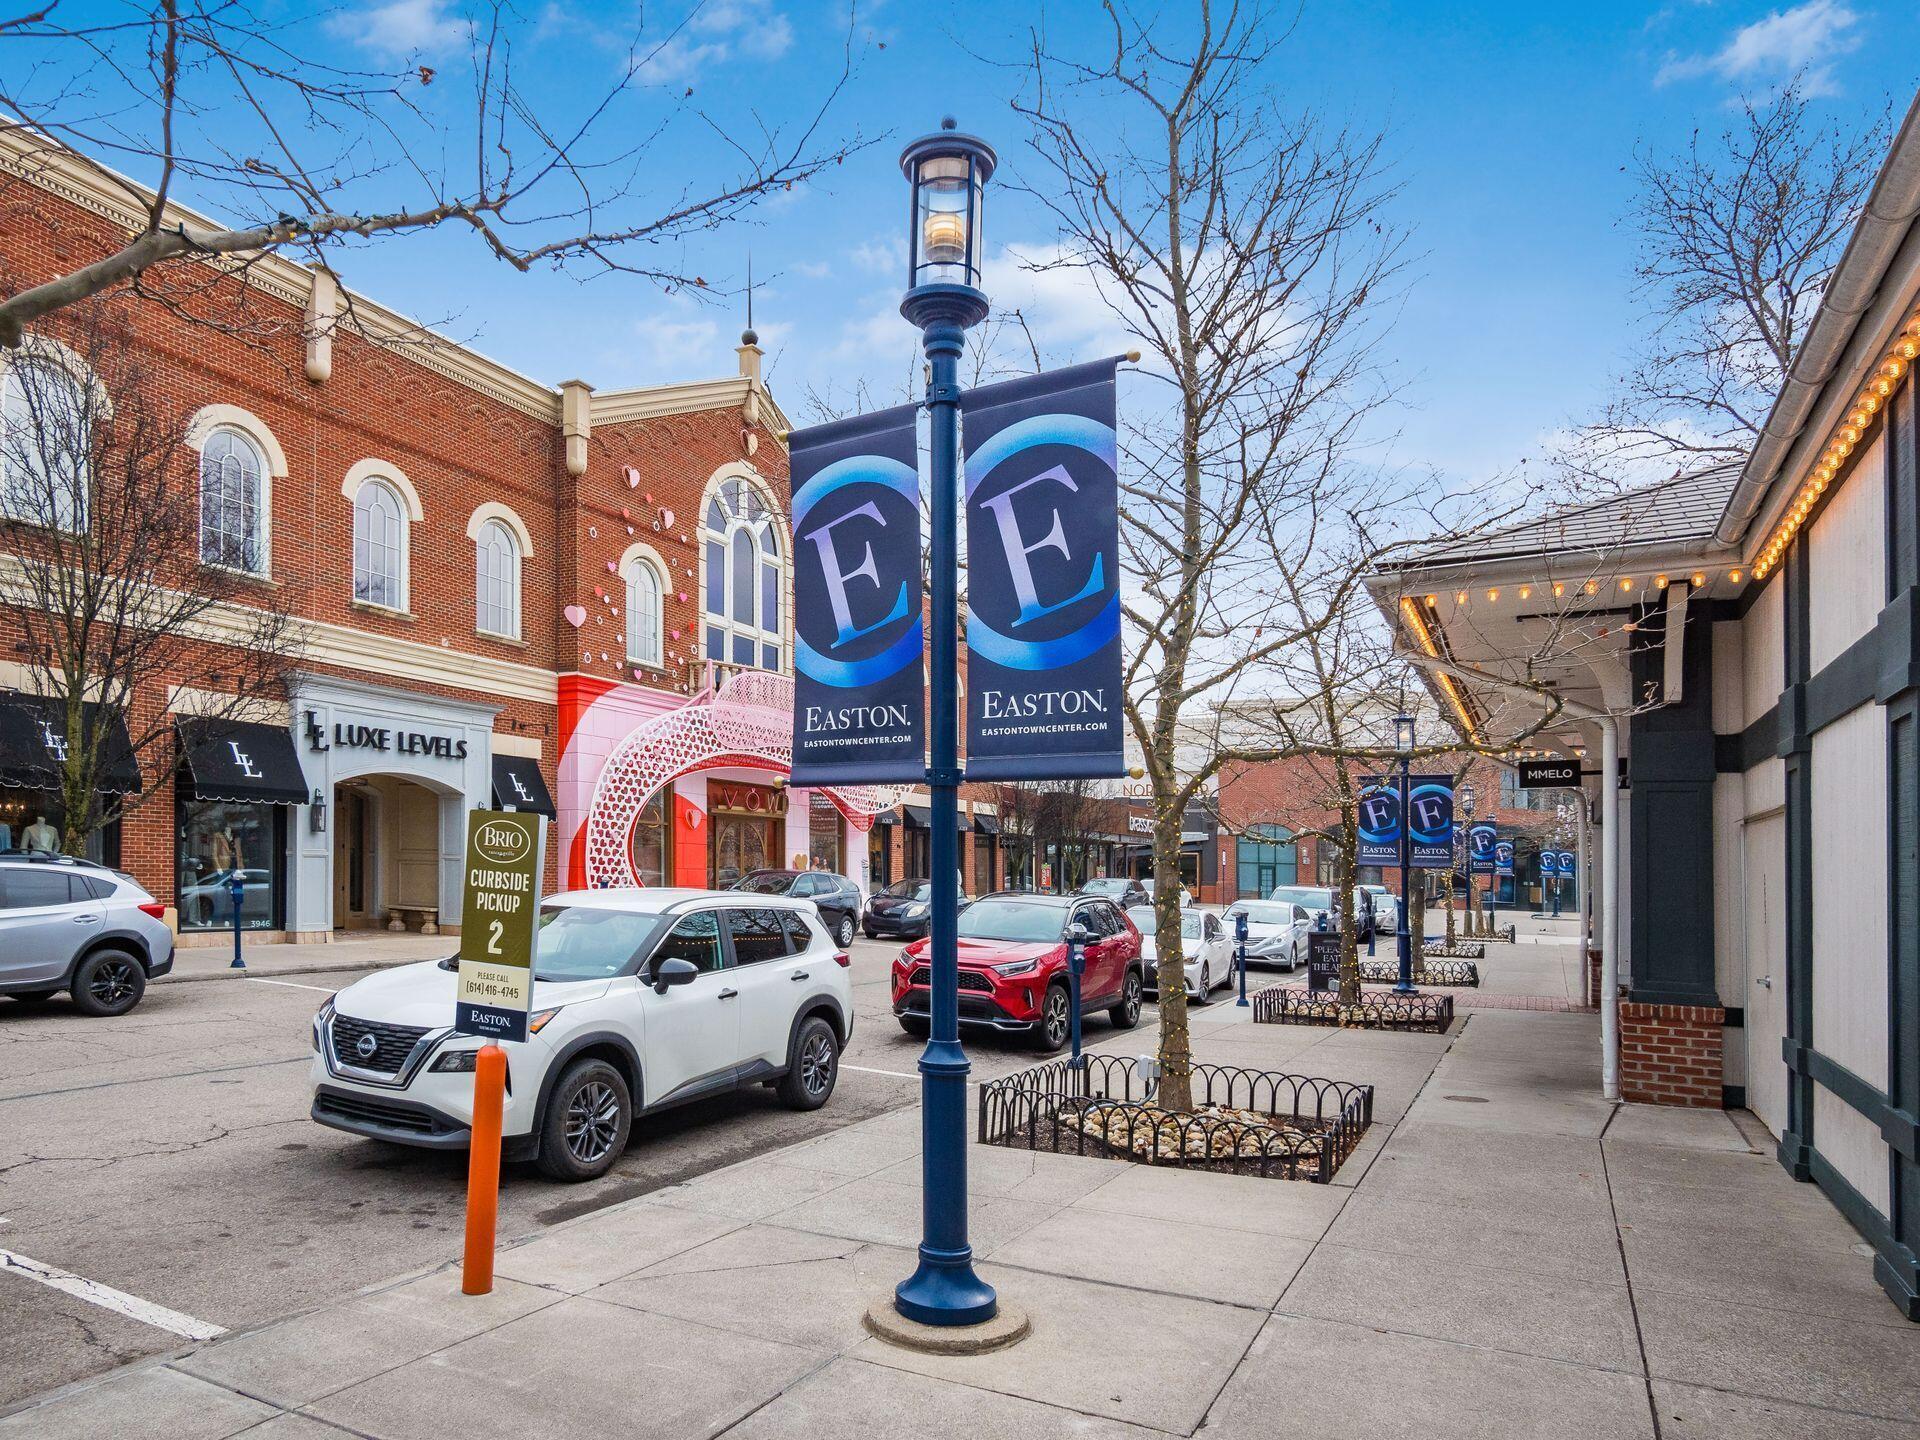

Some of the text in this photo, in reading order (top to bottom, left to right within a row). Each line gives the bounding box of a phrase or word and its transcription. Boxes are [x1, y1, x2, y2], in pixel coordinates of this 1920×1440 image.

[981, 721, 1108, 737] EASTONTOWNCENTER.COM
[335, 723, 468, 760] LUXE LEVELS
[804, 734, 912, 748] EASTONTOWNCENTER.COM
[1527, 768, 1573, 780] MMELO
[483, 826, 523, 849] BRIO
[470, 868, 530, 892] CURBSIDE
[476, 891, 521, 913] PICKUP
[250, 919, 271, 928] 3946
[487, 918, 504, 955] 2
[1311, 962, 1330, 971] THE
[477, 971, 509, 983] PLEASE CALL
